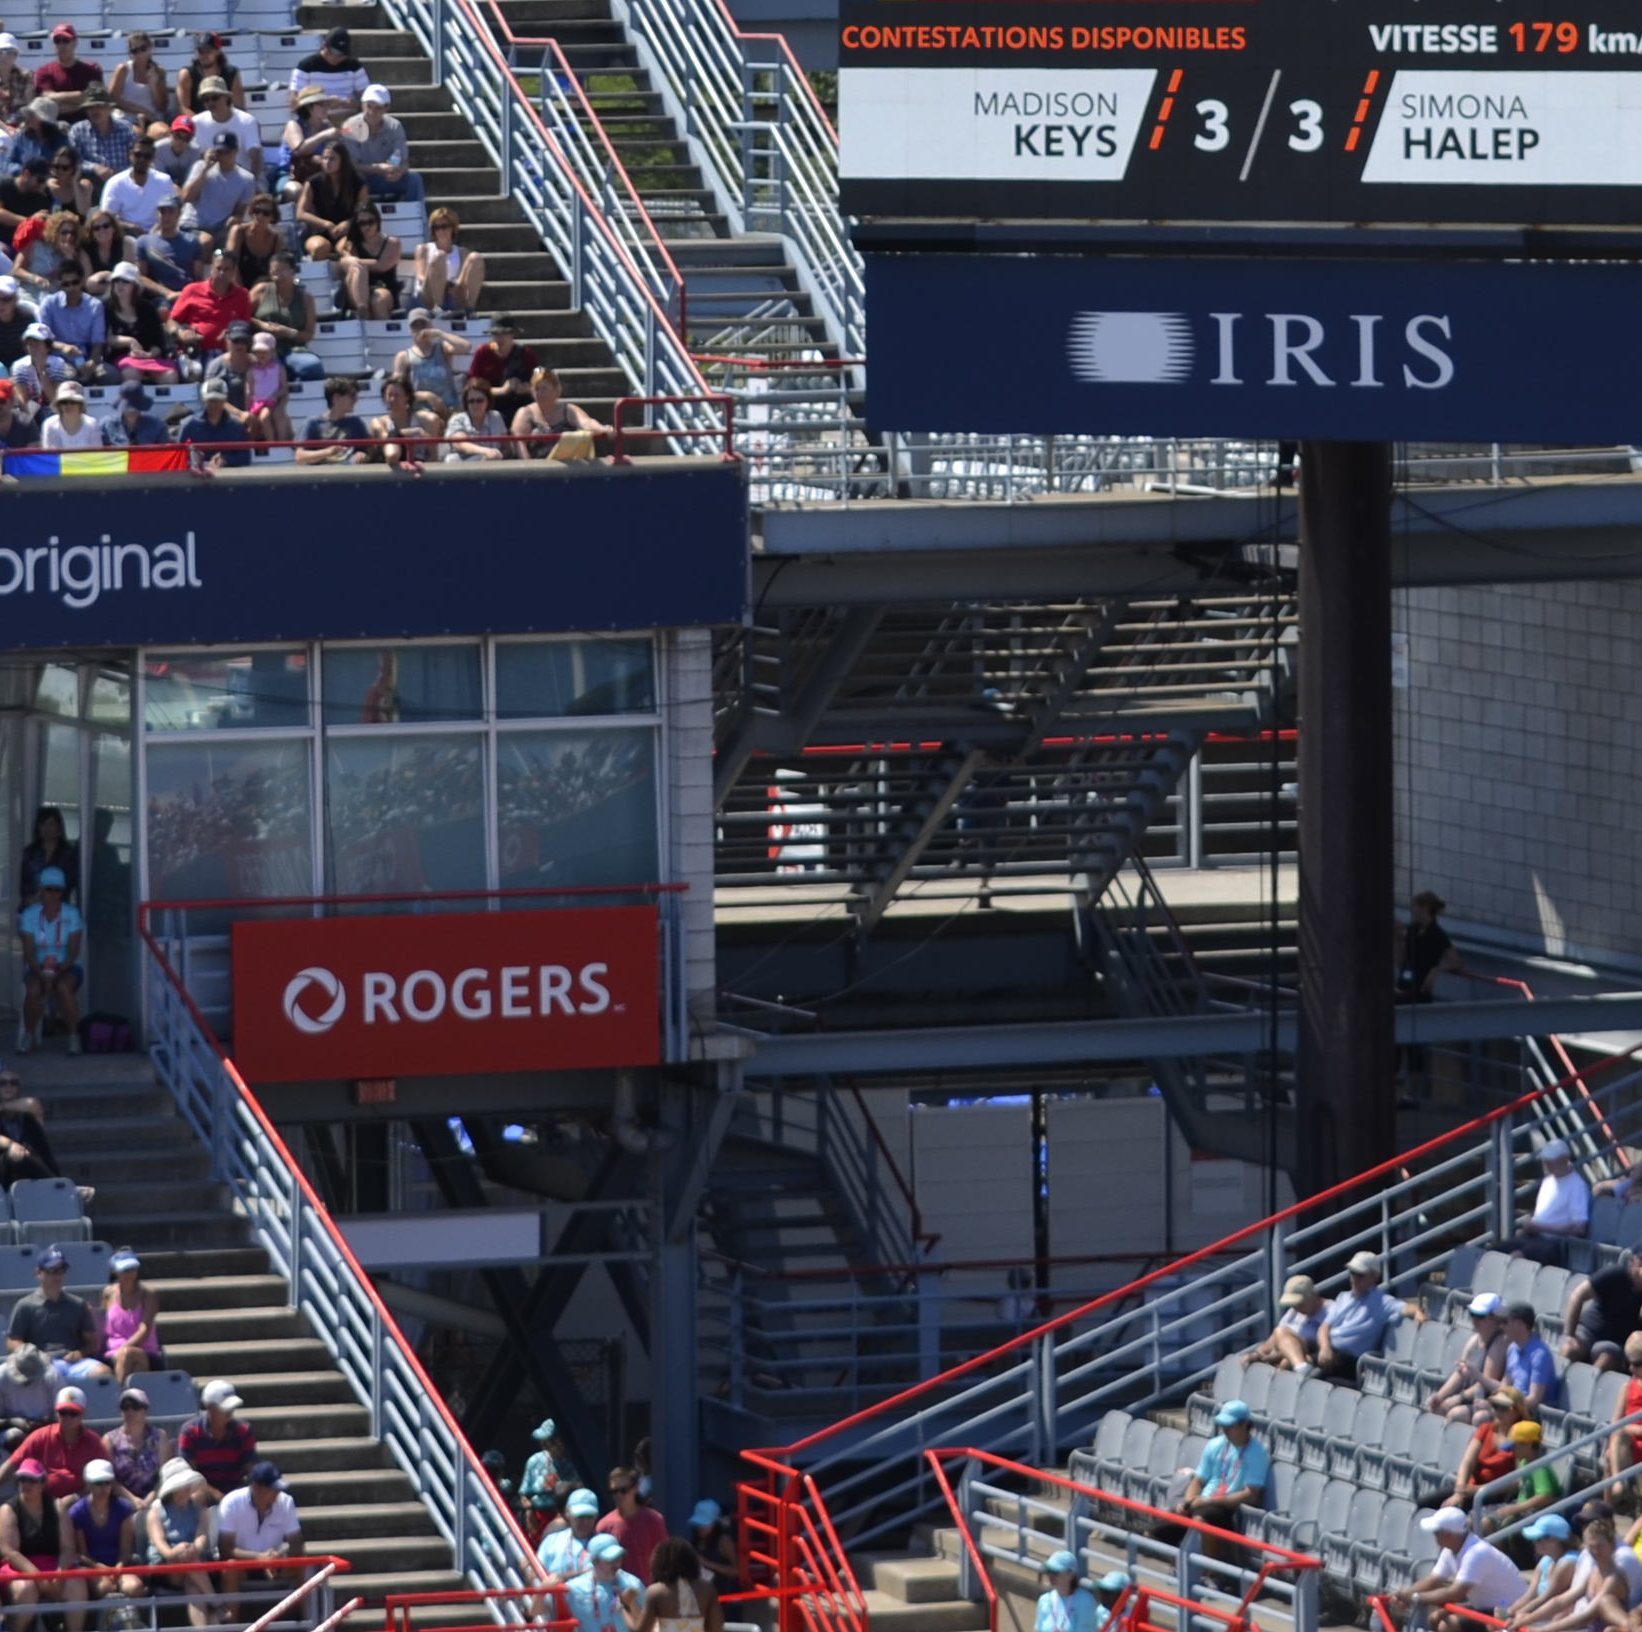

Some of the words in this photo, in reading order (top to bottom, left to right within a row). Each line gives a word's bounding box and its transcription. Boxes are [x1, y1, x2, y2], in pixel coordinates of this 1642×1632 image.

[842, 26, 1063, 49] CONTESTATIONS
[1072, 27, 1245, 49] DISPONIBLES
[1369, 25, 1497, 52] VITESSE
[1509, 22, 1578, 52] 179
[975, 92, 1117, 117] MADISON
[1402, 94, 1528, 119] SIMONA
[1015, 125, 1116, 157] KEYS
[1195, 100, 1229, 151] 3
[1289, 100, 1323, 151] 3
[1405, 128, 1539, 160] HALEP
[1210, 313, 1453, 388] IRIS
[364, 963, 609, 1023] ROGERS
